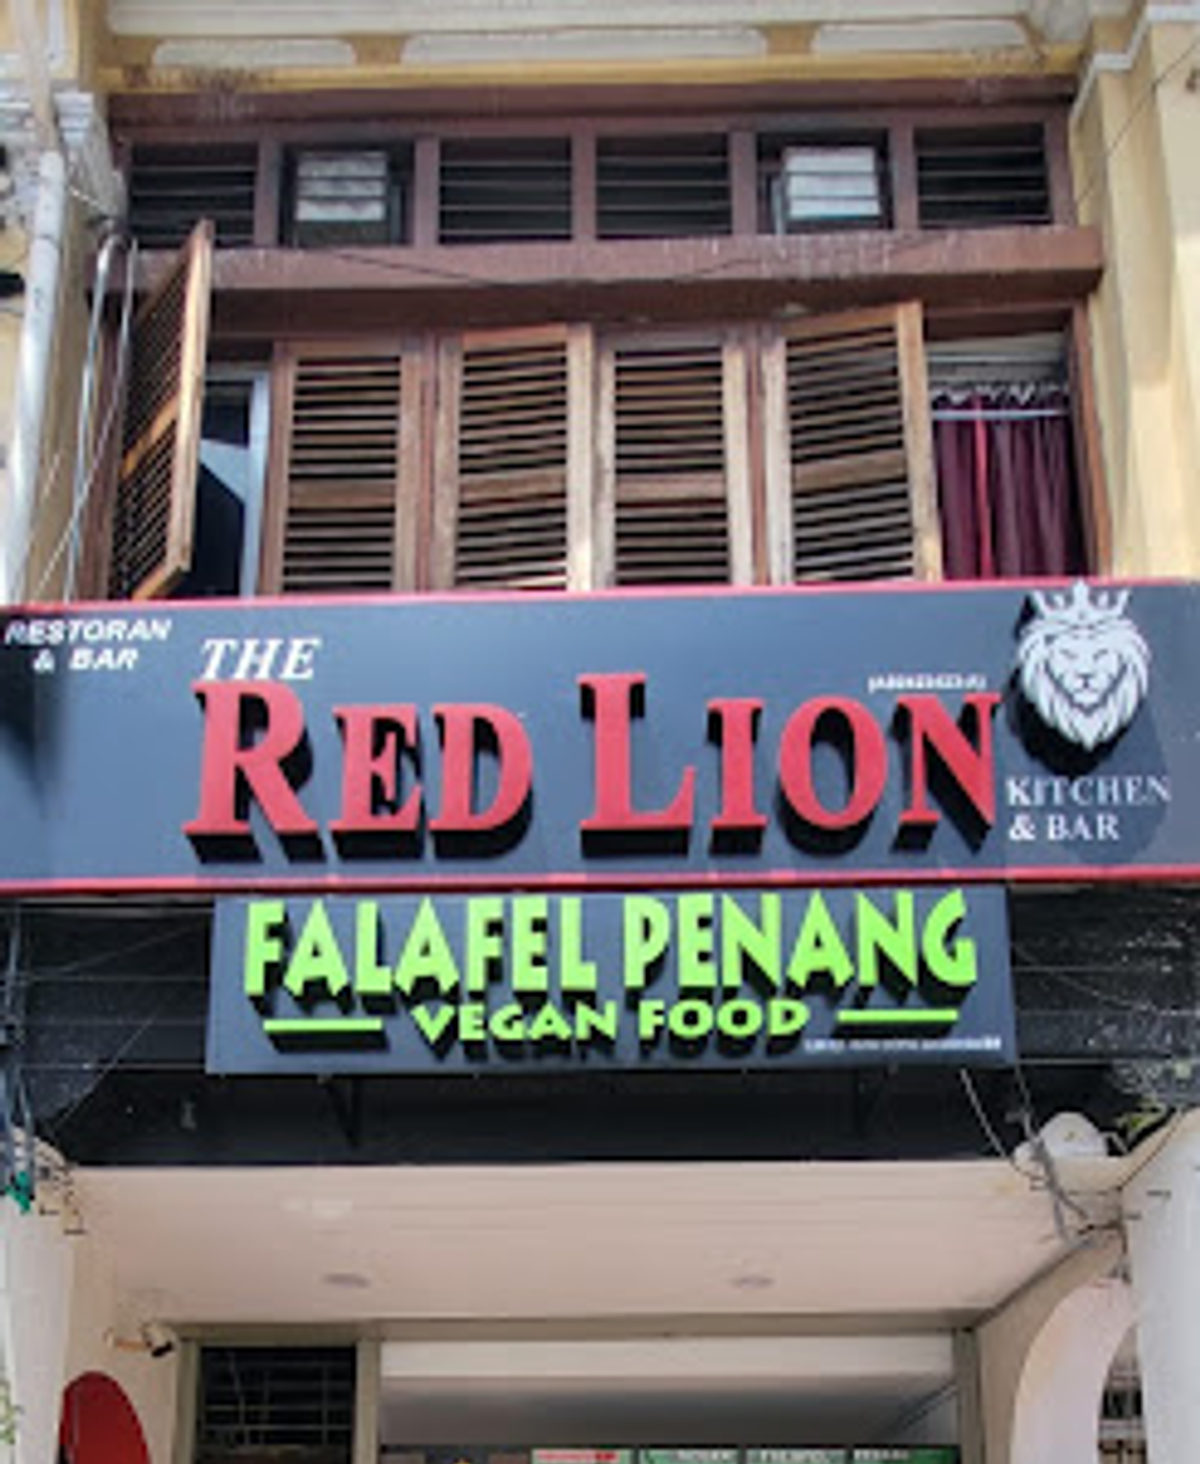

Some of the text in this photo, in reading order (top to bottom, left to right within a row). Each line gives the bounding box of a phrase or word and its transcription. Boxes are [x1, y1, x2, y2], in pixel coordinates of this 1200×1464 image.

[5, 618, 172, 645] RESTORAN
[33, 648, 139, 673] & BAR
[201, 638, 321, 680] THE
[181, 672, 1002, 834] RED LION
[1007, 775, 1172, 807] KITCHEN
[1008, 814, 1120, 841] & BAR
[244, 890, 977, 996] FALAFEL PENANG
[410, 999, 810, 1043] VEGAN FOOD
